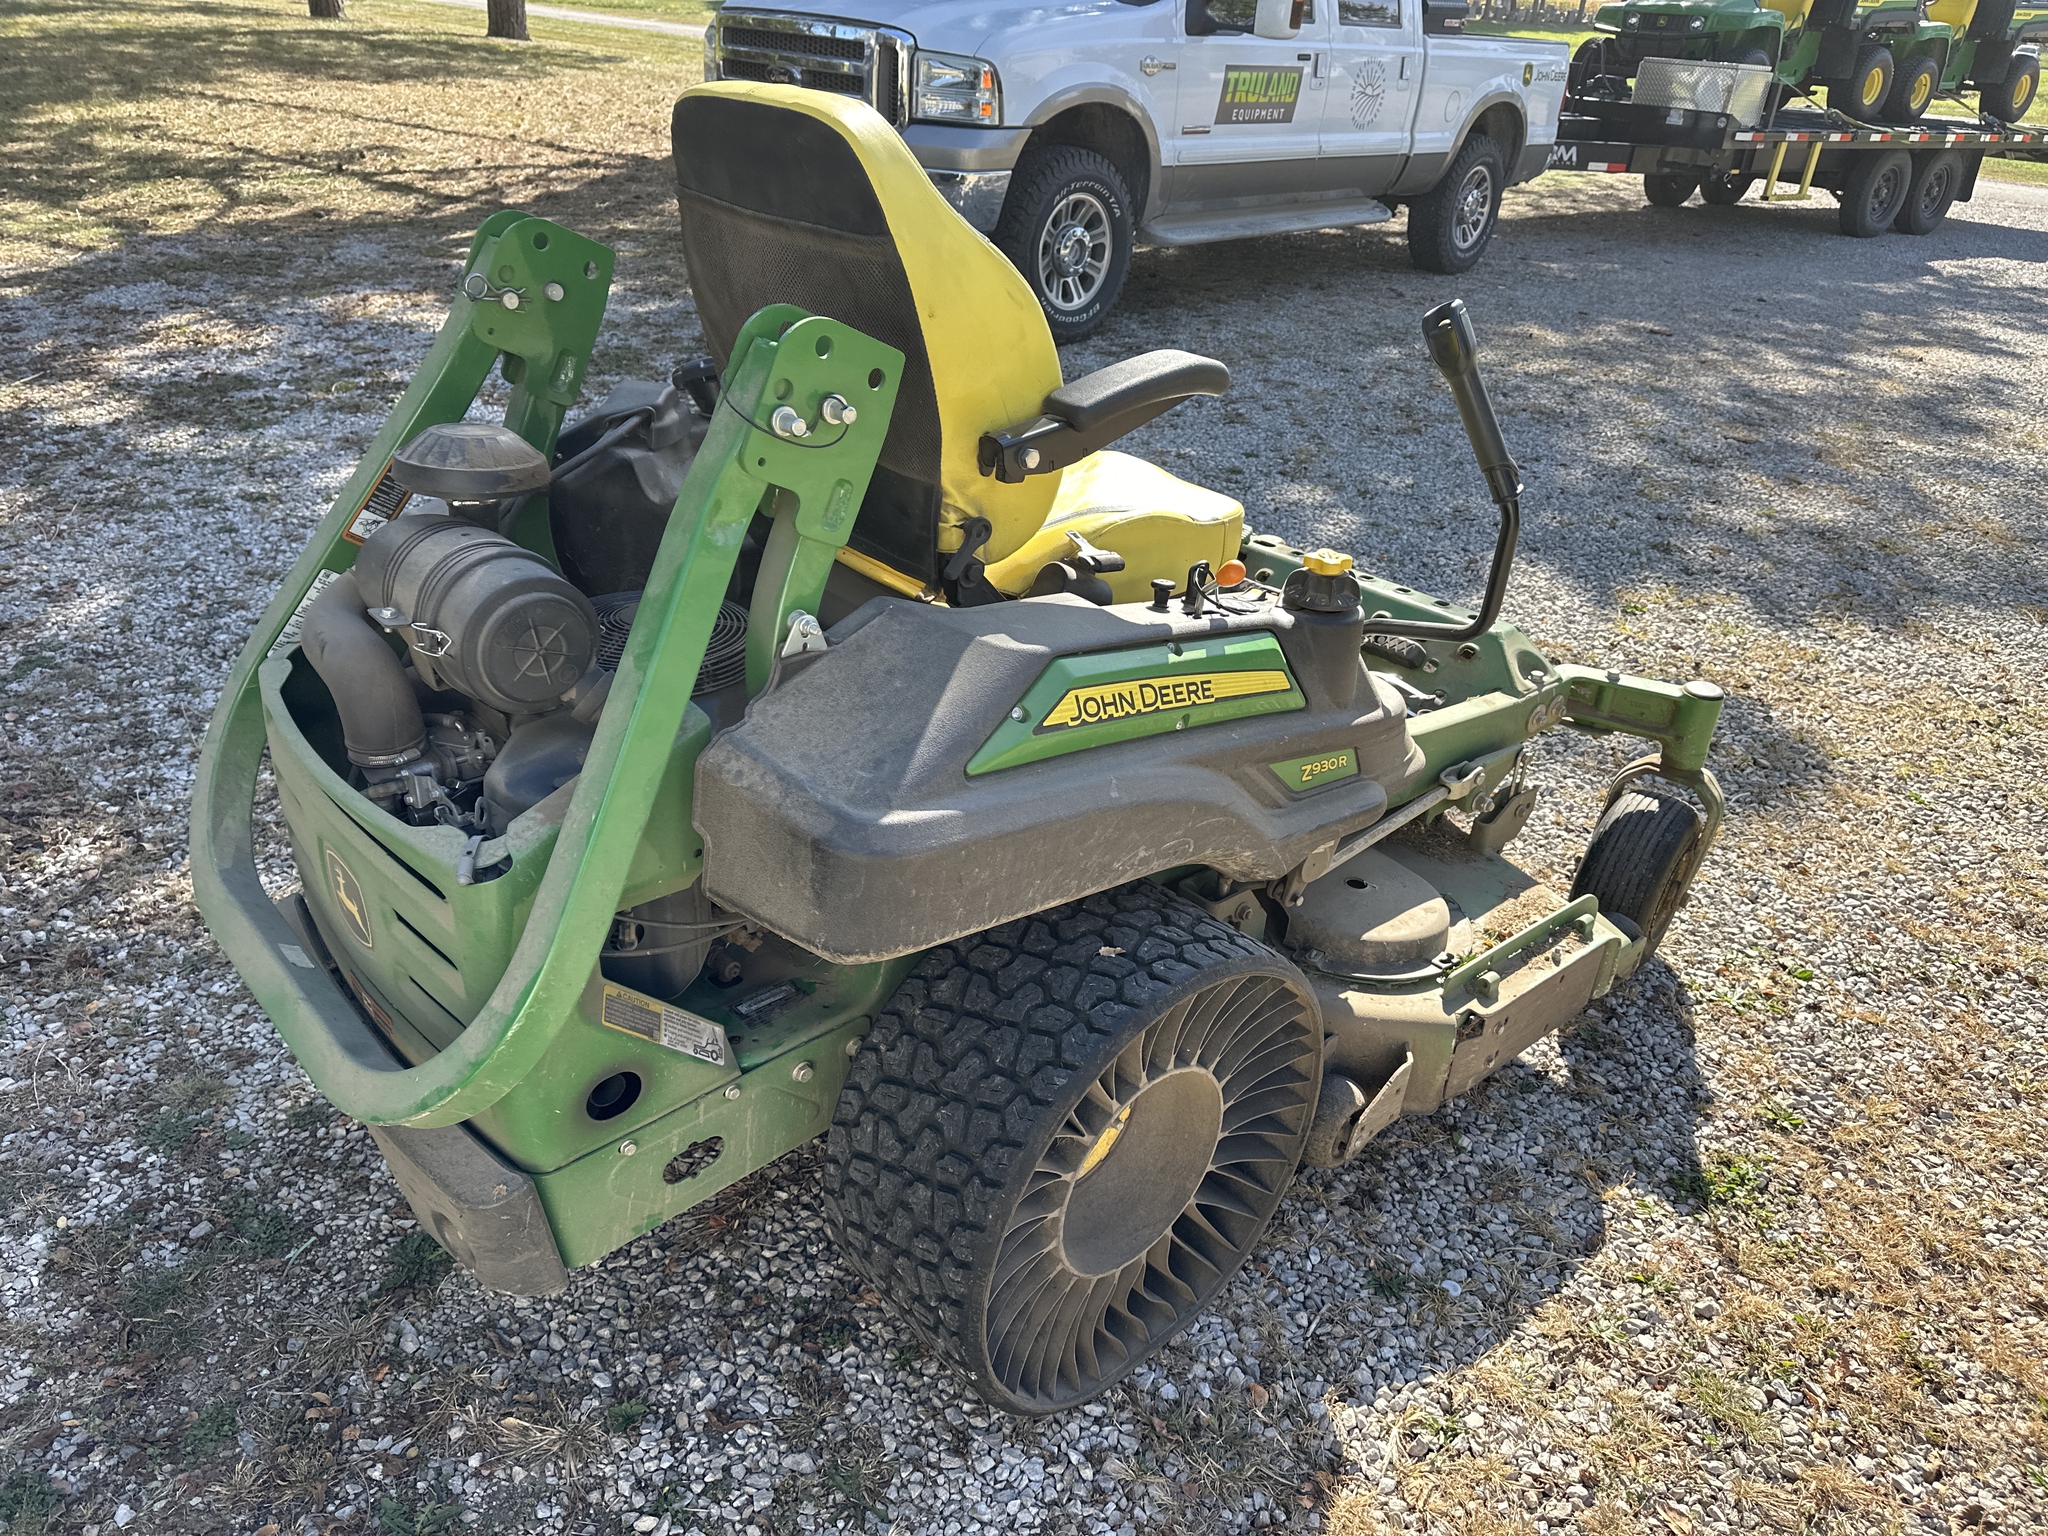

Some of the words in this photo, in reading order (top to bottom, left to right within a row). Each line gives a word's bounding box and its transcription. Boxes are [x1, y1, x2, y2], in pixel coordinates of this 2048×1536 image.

[1225, 71, 1299, 103] TRULAND
[1534, 69, 1550, 82] JOHN
[1550, 69, 1567, 82] DEERE
[1231, 108, 1285, 121] EQUIPMENT
[1041, 297, 1100, 323] BFGoodrich
[1069, 690, 1136, 722] JOHN
[1138, 680, 1215, 709] DEERE
[1301, 755, 1347, 782] Z930R
[622, 992, 651, 1009] CAUTION
